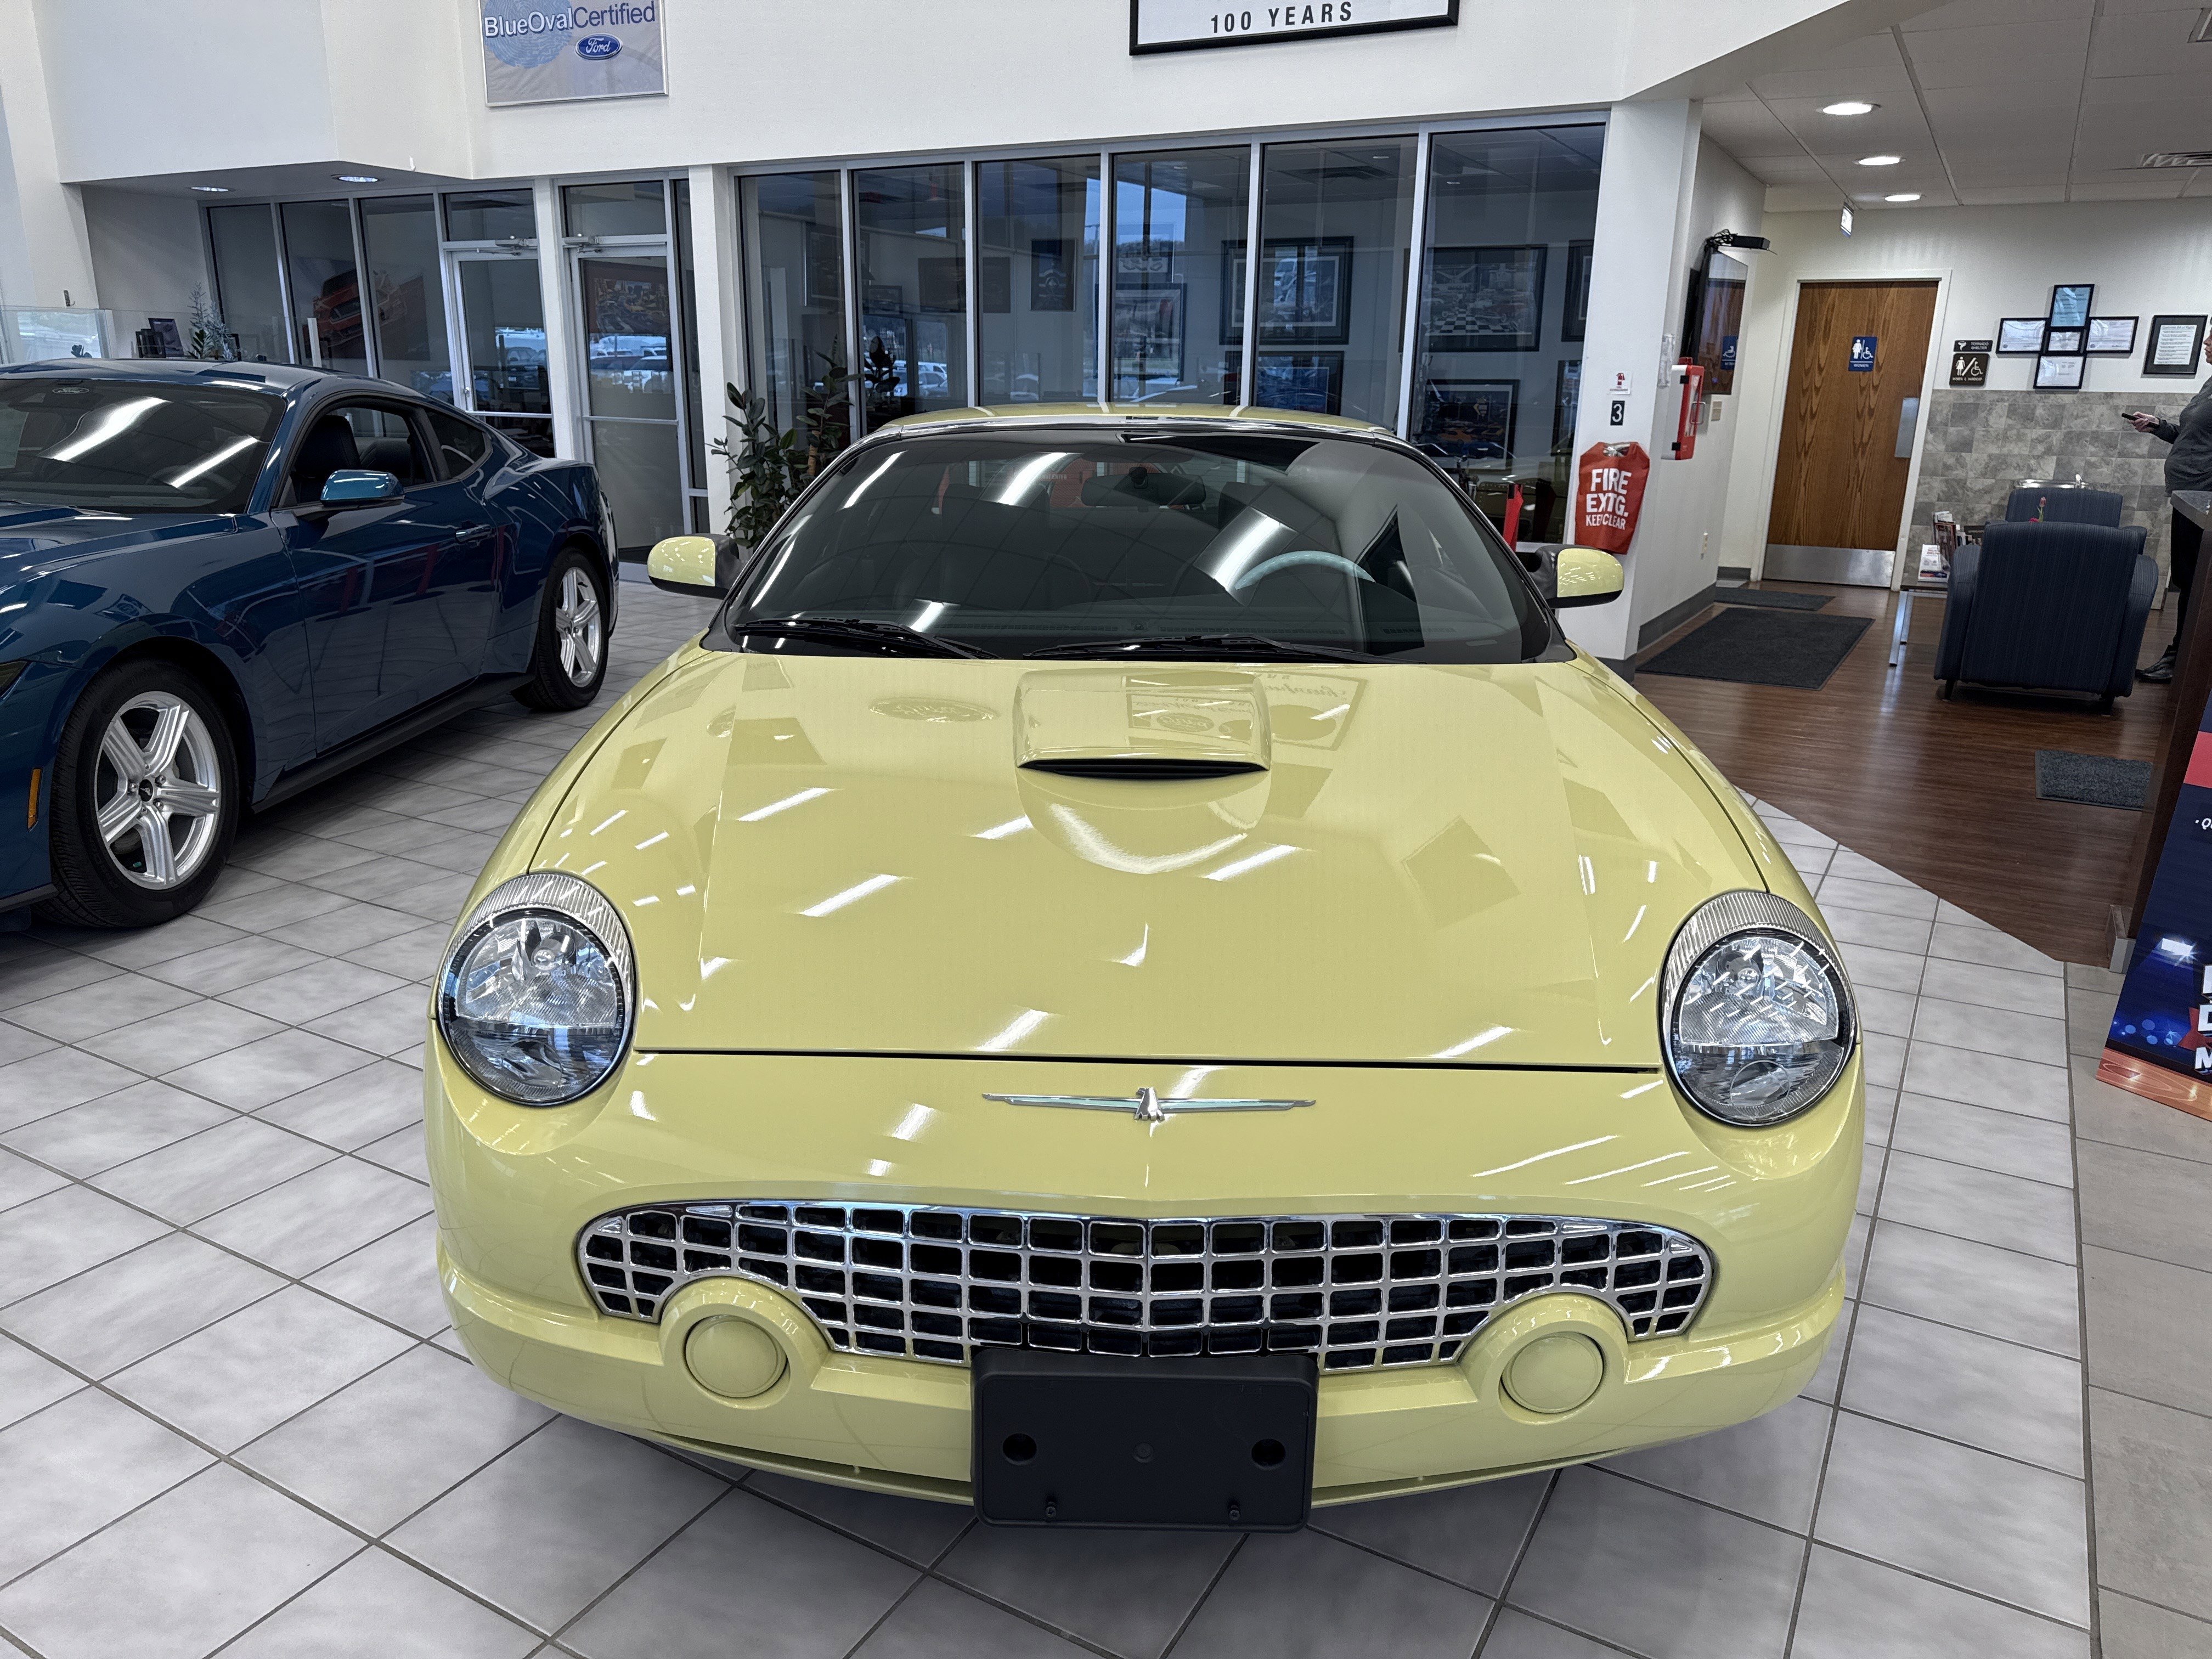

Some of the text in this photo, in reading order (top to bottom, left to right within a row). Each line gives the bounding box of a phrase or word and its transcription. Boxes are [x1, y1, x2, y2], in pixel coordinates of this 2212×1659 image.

[484, 0, 656, 37] BlueOvalCertified
[1211, 2, 1351, 33] 100 YEARS
[585, 37, 611, 53] Ford
[1612, 403, 1622, 422] 3
[1590, 468, 1632, 495] FIRE
[1586, 493, 1629, 517] EXTG.
[1602, 514, 1626, 531] CLEAR
